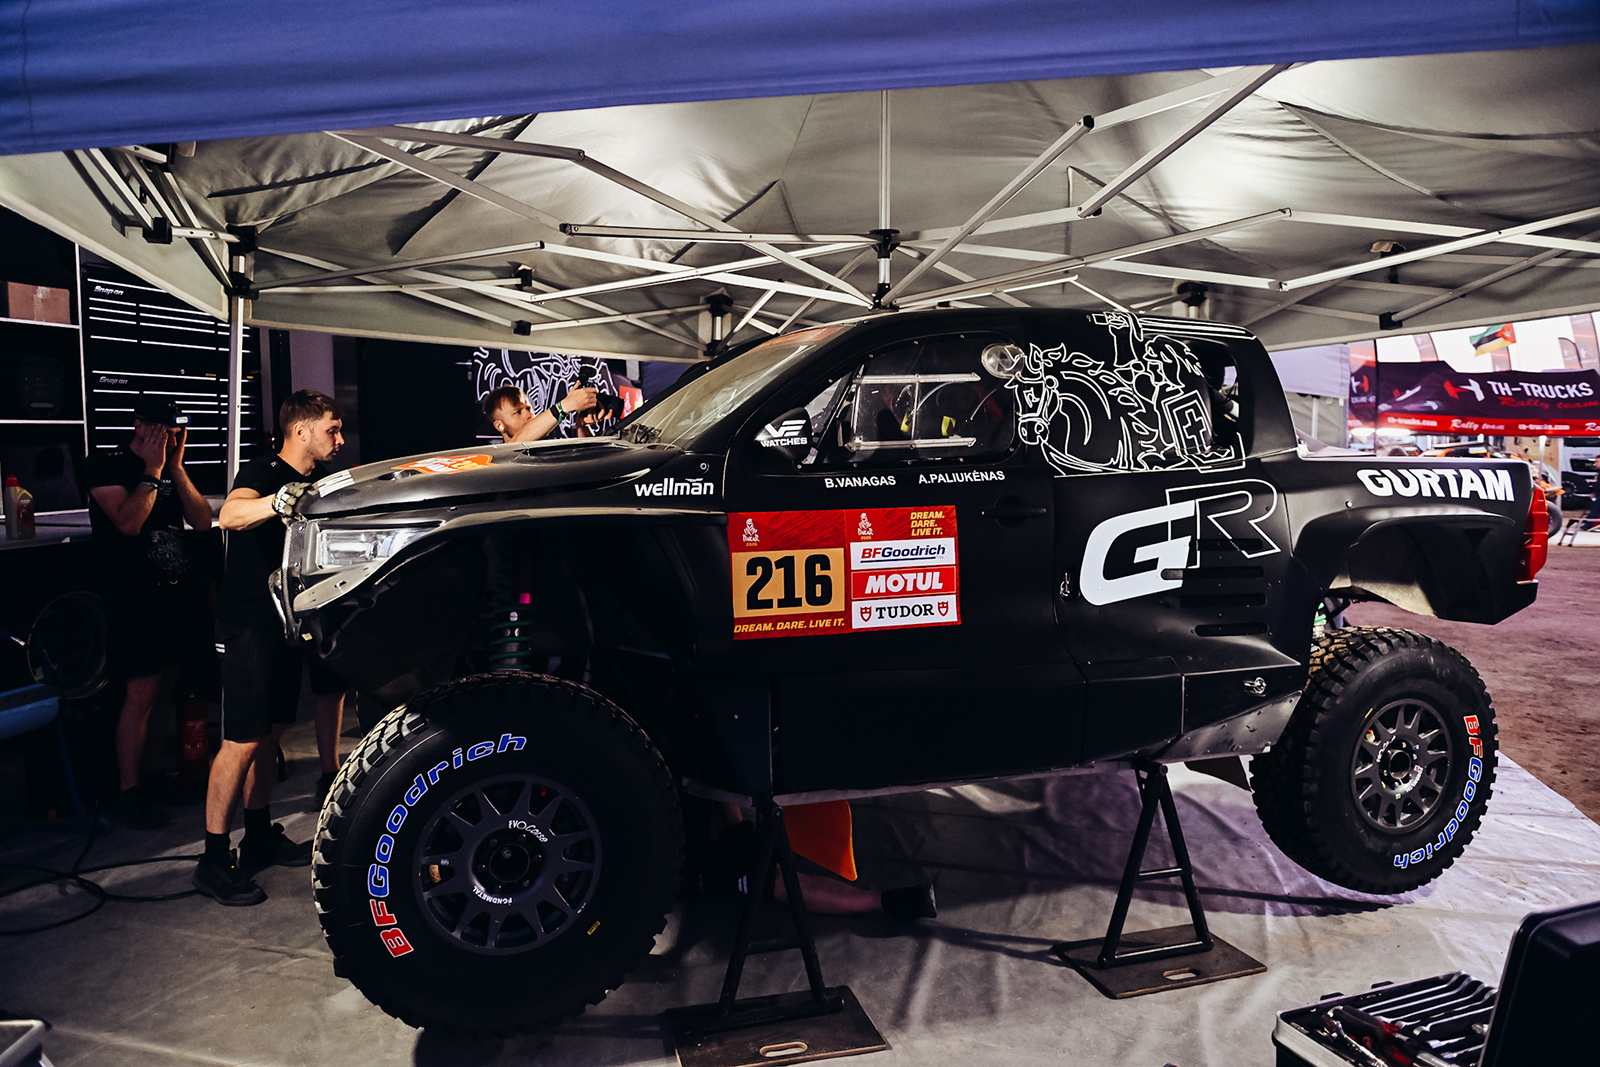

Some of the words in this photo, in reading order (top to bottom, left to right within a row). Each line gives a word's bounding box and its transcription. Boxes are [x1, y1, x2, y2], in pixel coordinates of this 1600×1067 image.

[1487, 380, 1594, 399] TH-TRUCKS
[1499, 397, 1549, 409] Rally
[1451, 419, 1479, 431] Rally
[760, 437, 808, 448] WATCHES
[824, 475, 896, 489] B.VANAGAS
[918, 470, 1005, 485] A.PALIUKĖNAS
[1356, 468, 1515, 502] GURTAM
[910, 511, 945, 520] DREAM.
[911, 520, 937, 528] DARE.
[911, 528, 932, 537] LIVE
[933, 527, 943, 536] IT.
[1079, 478, 1281, 606] GR
[861, 544, 946, 559] BFGoodrich
[746, 553, 833, 611] 216
[864, 571, 944, 594] MOTUL
[876, 603, 935, 620] TUDOR
[734, 622, 775, 634] DREAM.
[776, 620, 807, 631] DARE.
[808, 619, 833, 629] LIVE
[833, 617, 845, 627] IT.
[1393, 714, 1484, 869] BFGoodrich
[366, 732, 528, 959] BFGoodrich
